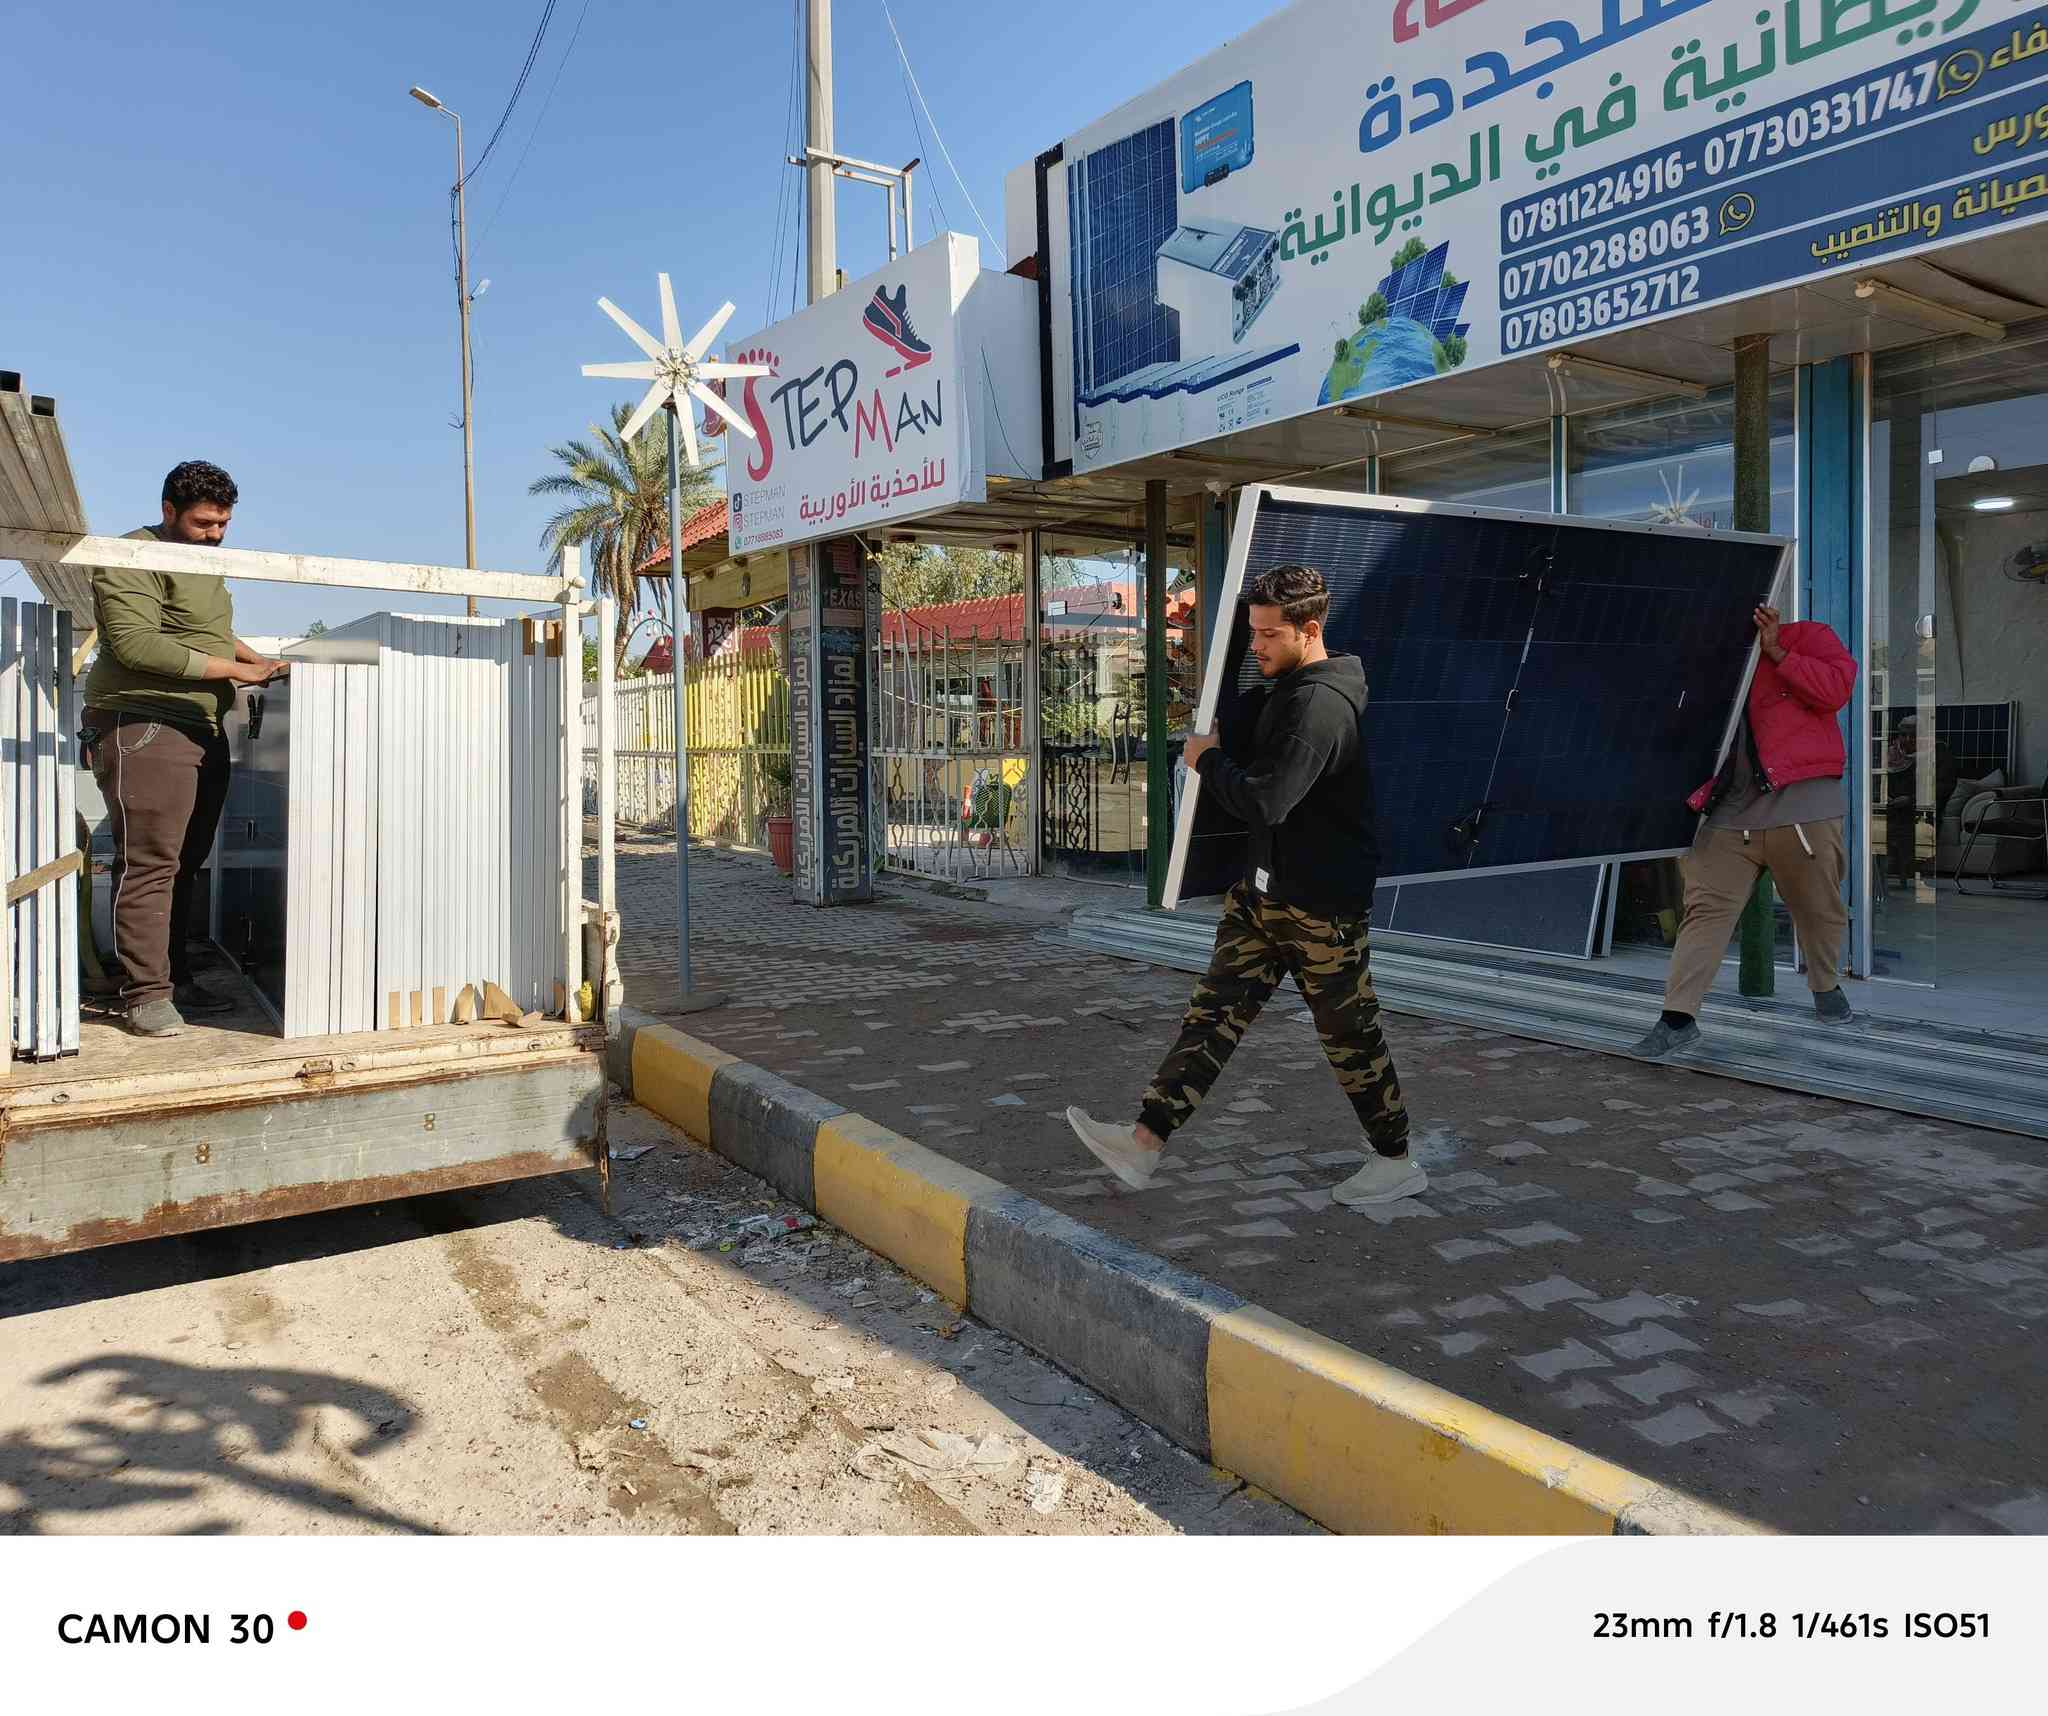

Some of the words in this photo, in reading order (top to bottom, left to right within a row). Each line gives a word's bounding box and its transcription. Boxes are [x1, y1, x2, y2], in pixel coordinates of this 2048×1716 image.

[1524, 72, 1637, 181] في
[1704, 59, 1939, 176] 07730331747
[1279, 123, 1501, 266] الديوانية
[1811, 201, 1942, 264] والتنصيب
[1504, 206, 1710, 300] 07702288063
[1506, 265, 1700, 349] 07803652712
[800, 478, 866, 526] الأوربية
[870, 457, 945, 508] للأحذية
